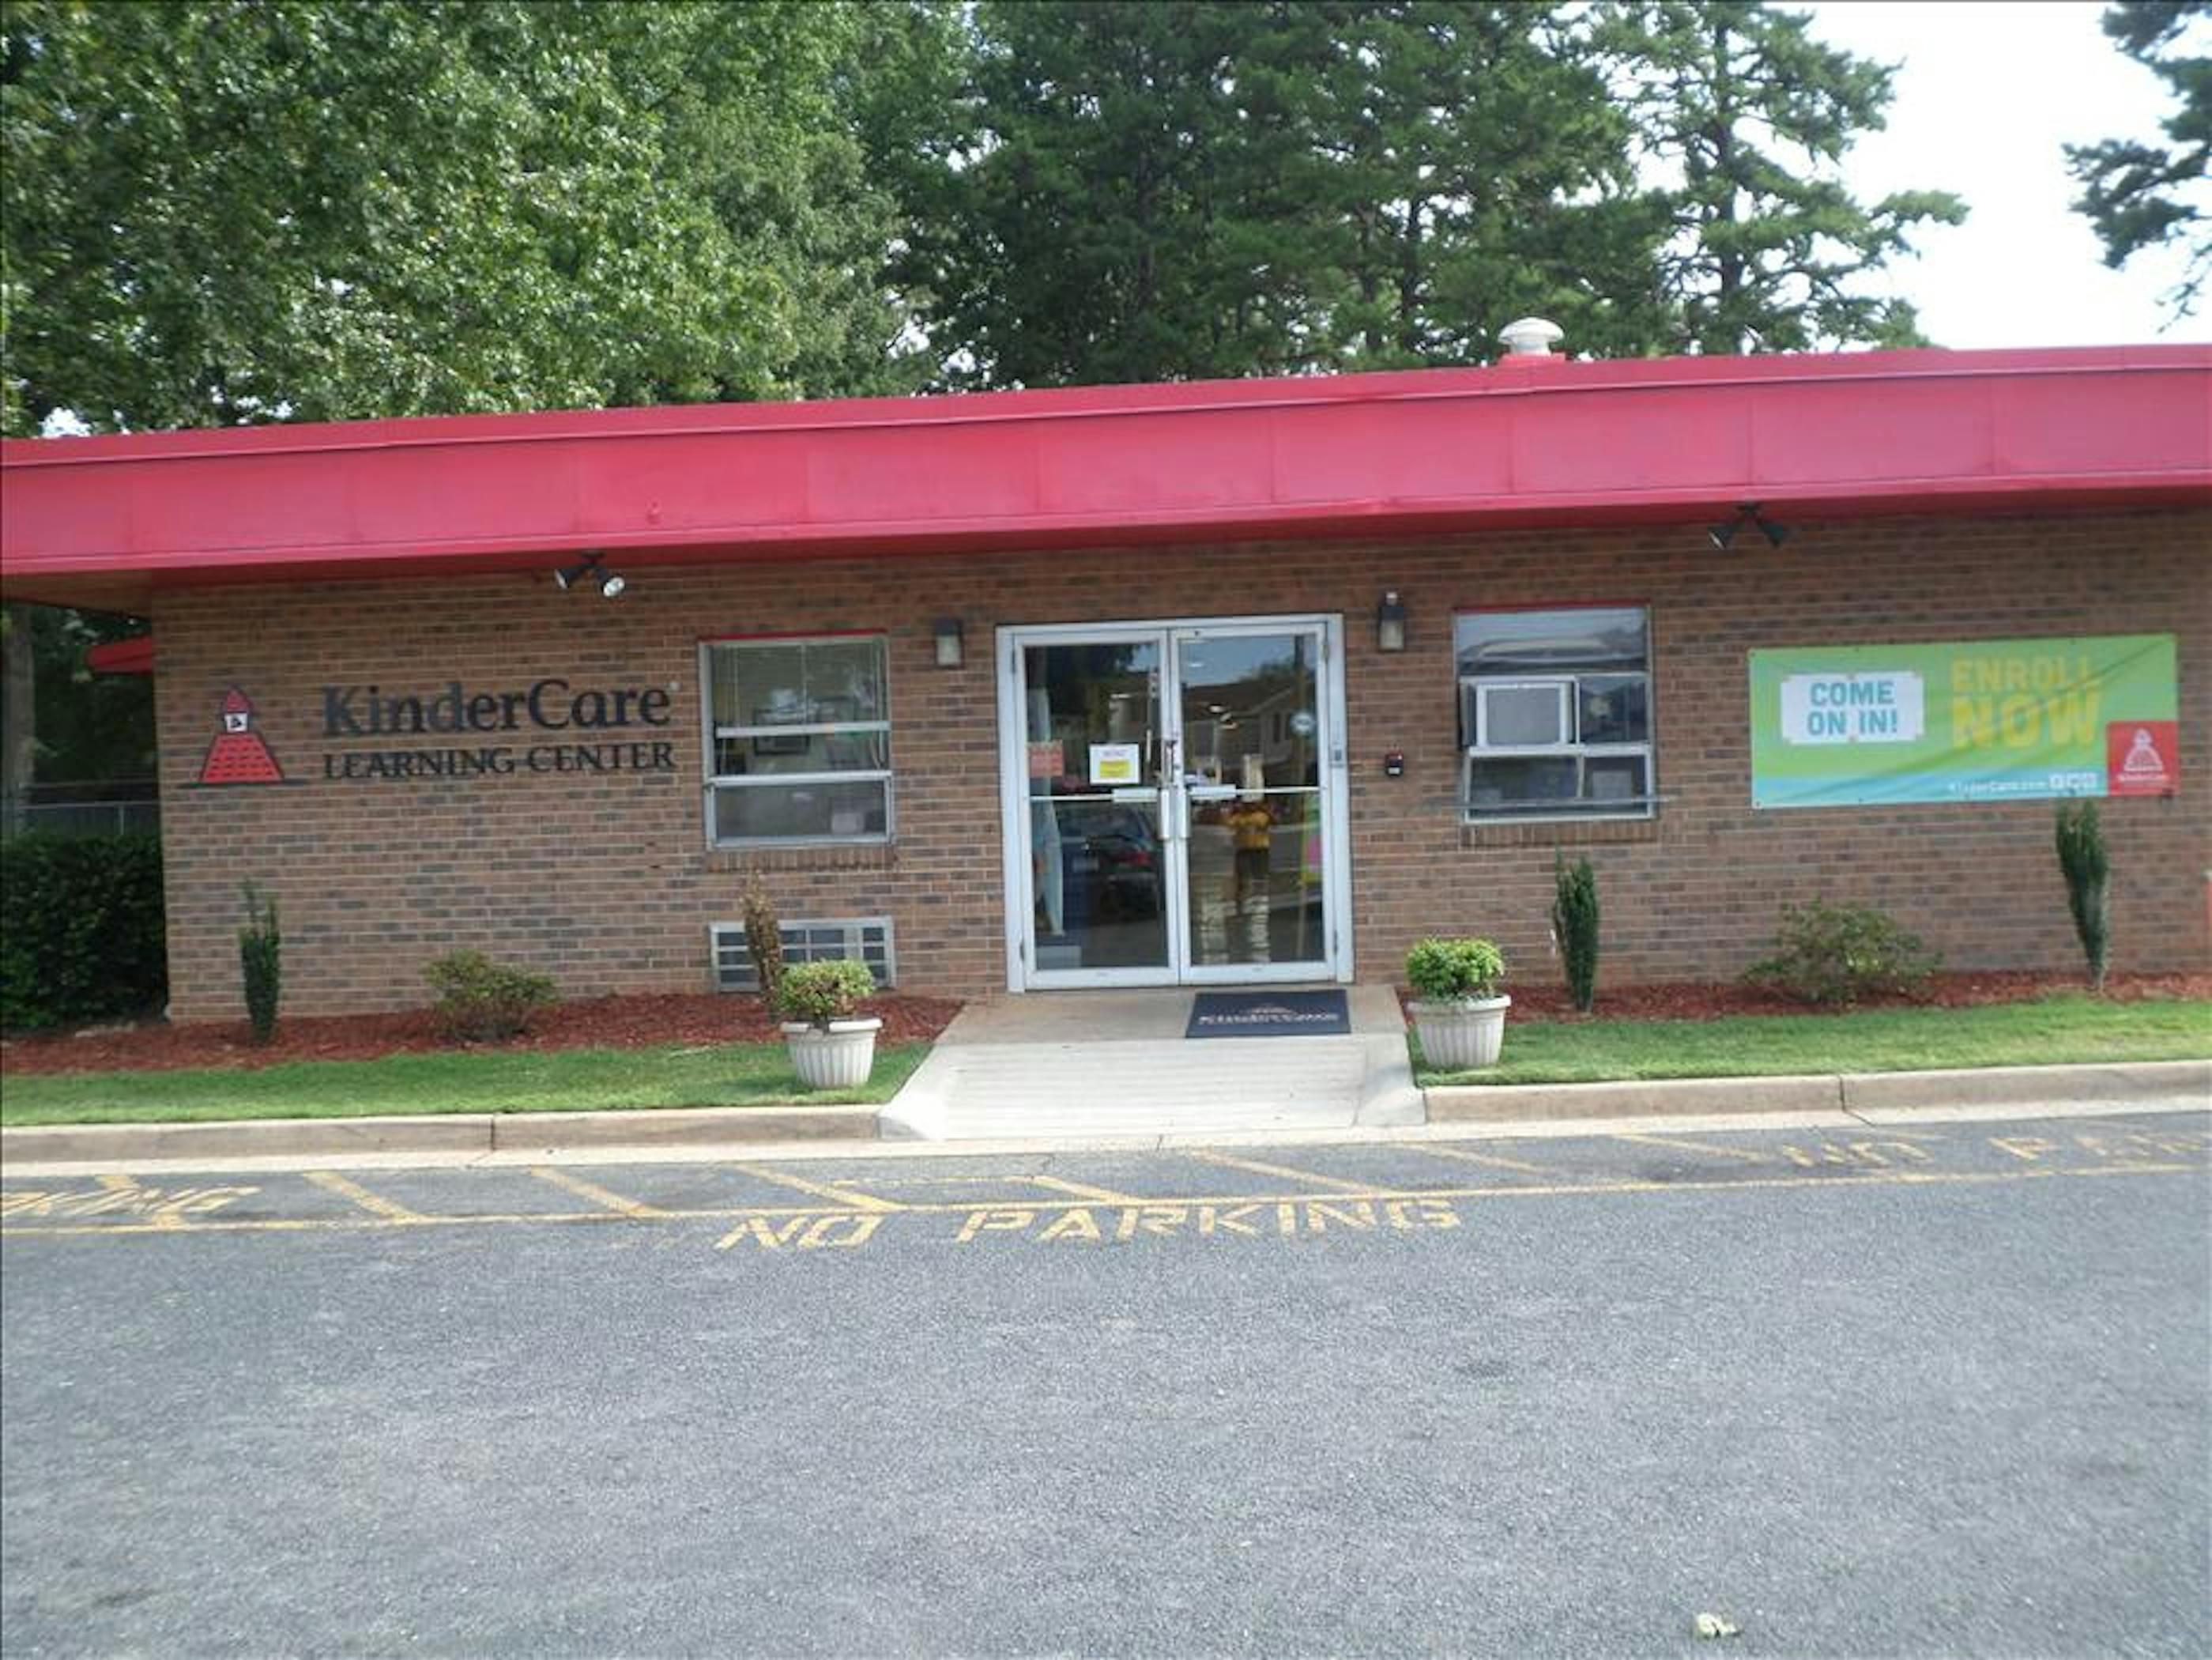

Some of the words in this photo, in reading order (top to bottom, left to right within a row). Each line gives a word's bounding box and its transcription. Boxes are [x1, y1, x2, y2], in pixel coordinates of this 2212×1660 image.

[1950, 655, 2101, 693] ENROLL
[321, 678, 673, 738] KinderCare
[1809, 681, 1896, 707] COME
[1806, 711, 1848, 736] ON
[1859, 709, 1897, 734] IN!
[1950, 689, 2102, 750] NOW
[322, 745, 515, 779] LEARNING
[526, 741, 675, 772] CENTER
[714, 1215, 885, 1250] NO
[954, 1199, 1463, 1243] PARKING
